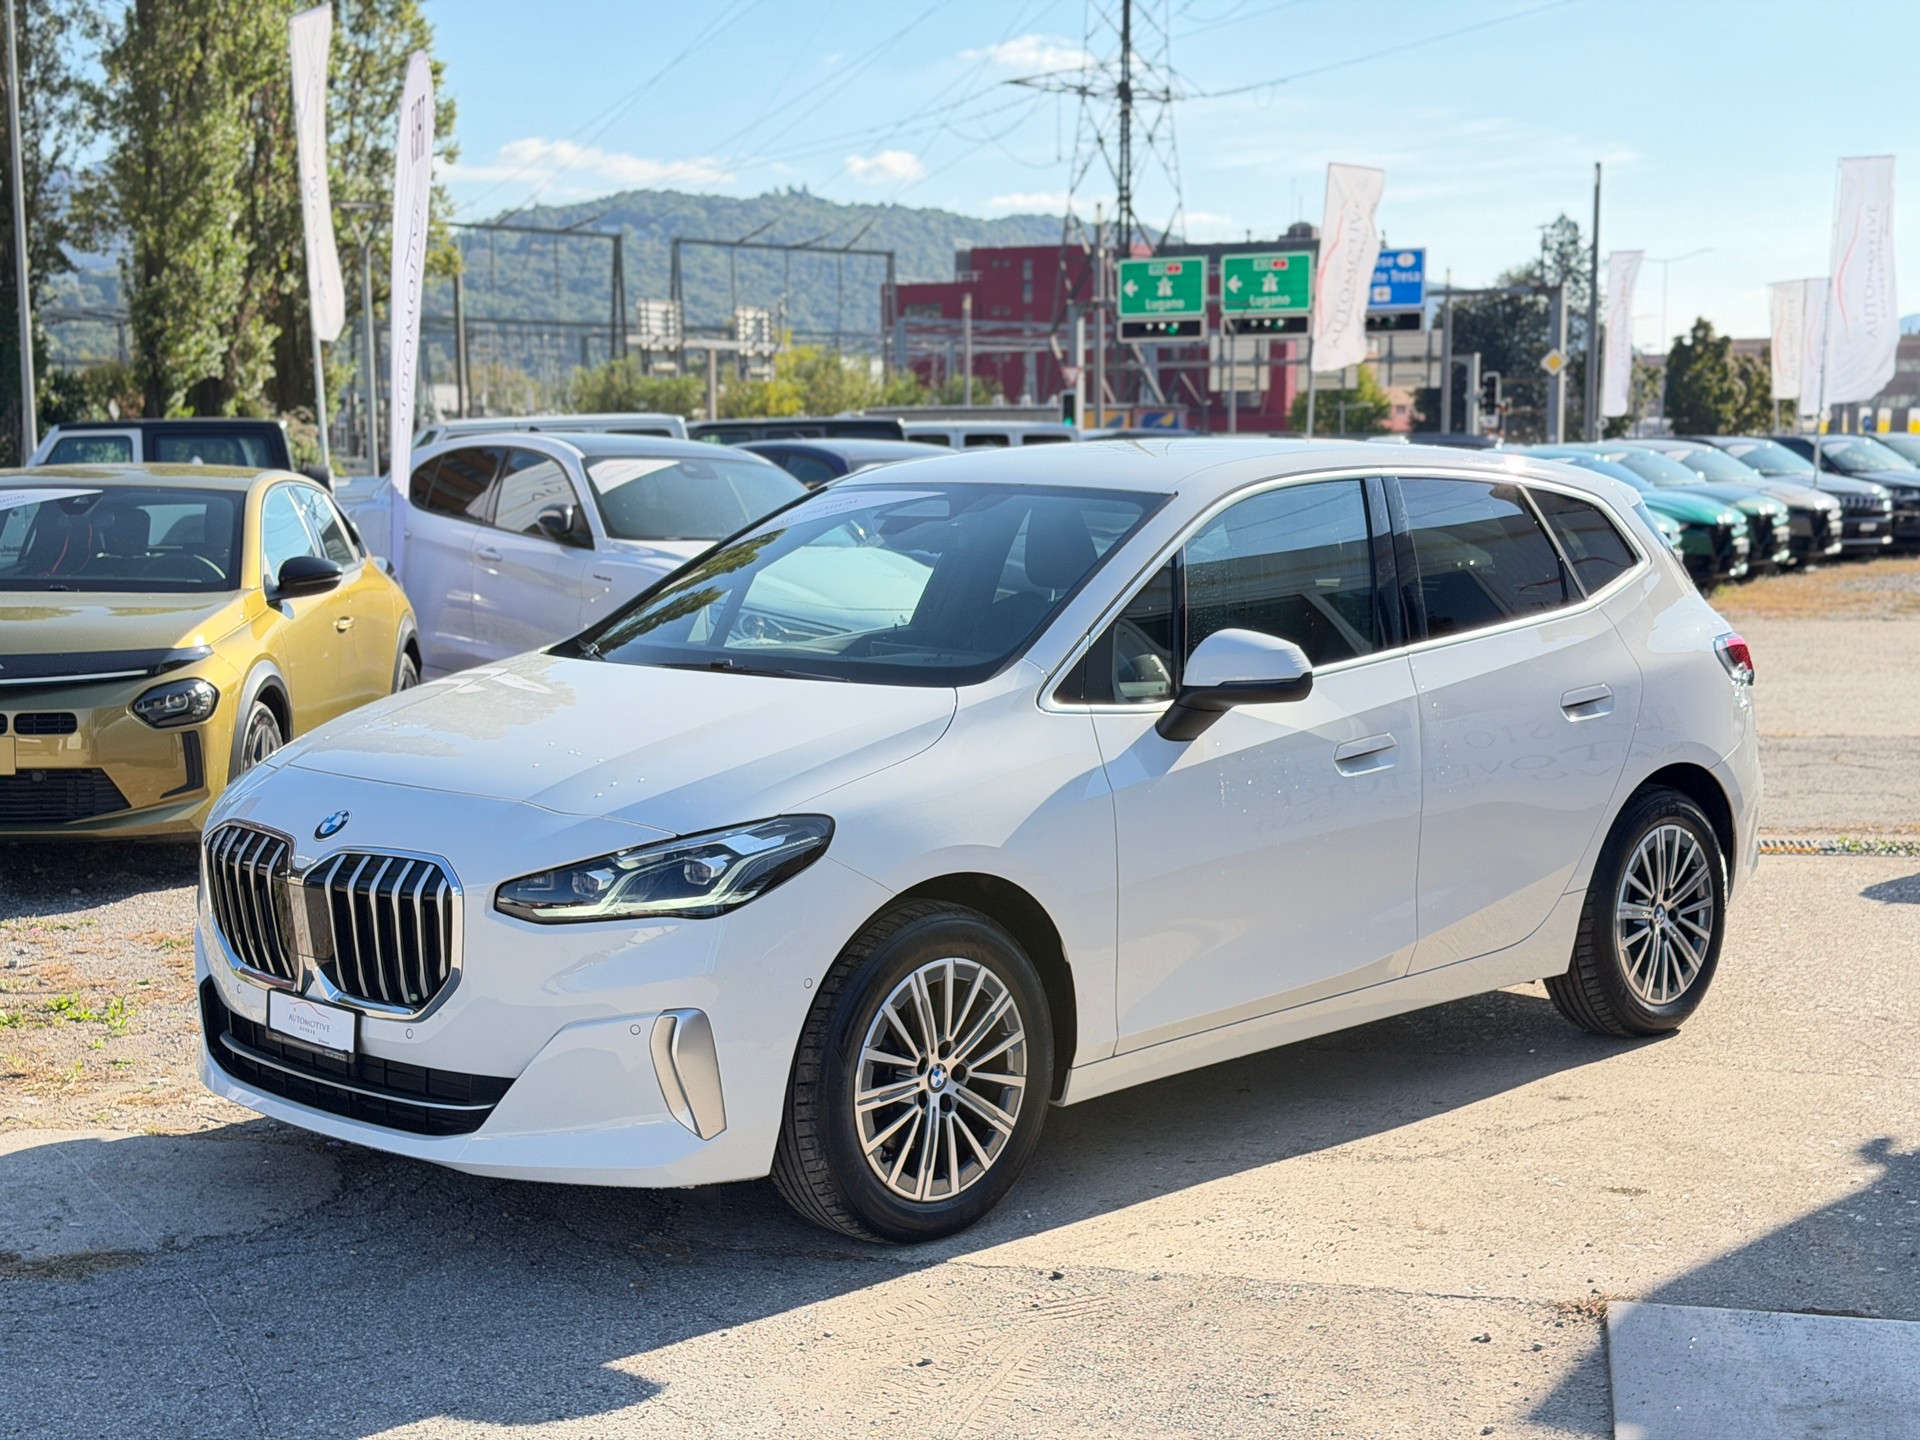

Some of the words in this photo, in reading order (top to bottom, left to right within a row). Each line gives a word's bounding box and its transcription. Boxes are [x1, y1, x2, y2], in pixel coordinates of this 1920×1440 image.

[1145, 299, 1185, 313] Lugano
[1249, 295, 1291, 310] Lugano
[288, 1013, 331, 1033] AUTOMOTIVE
